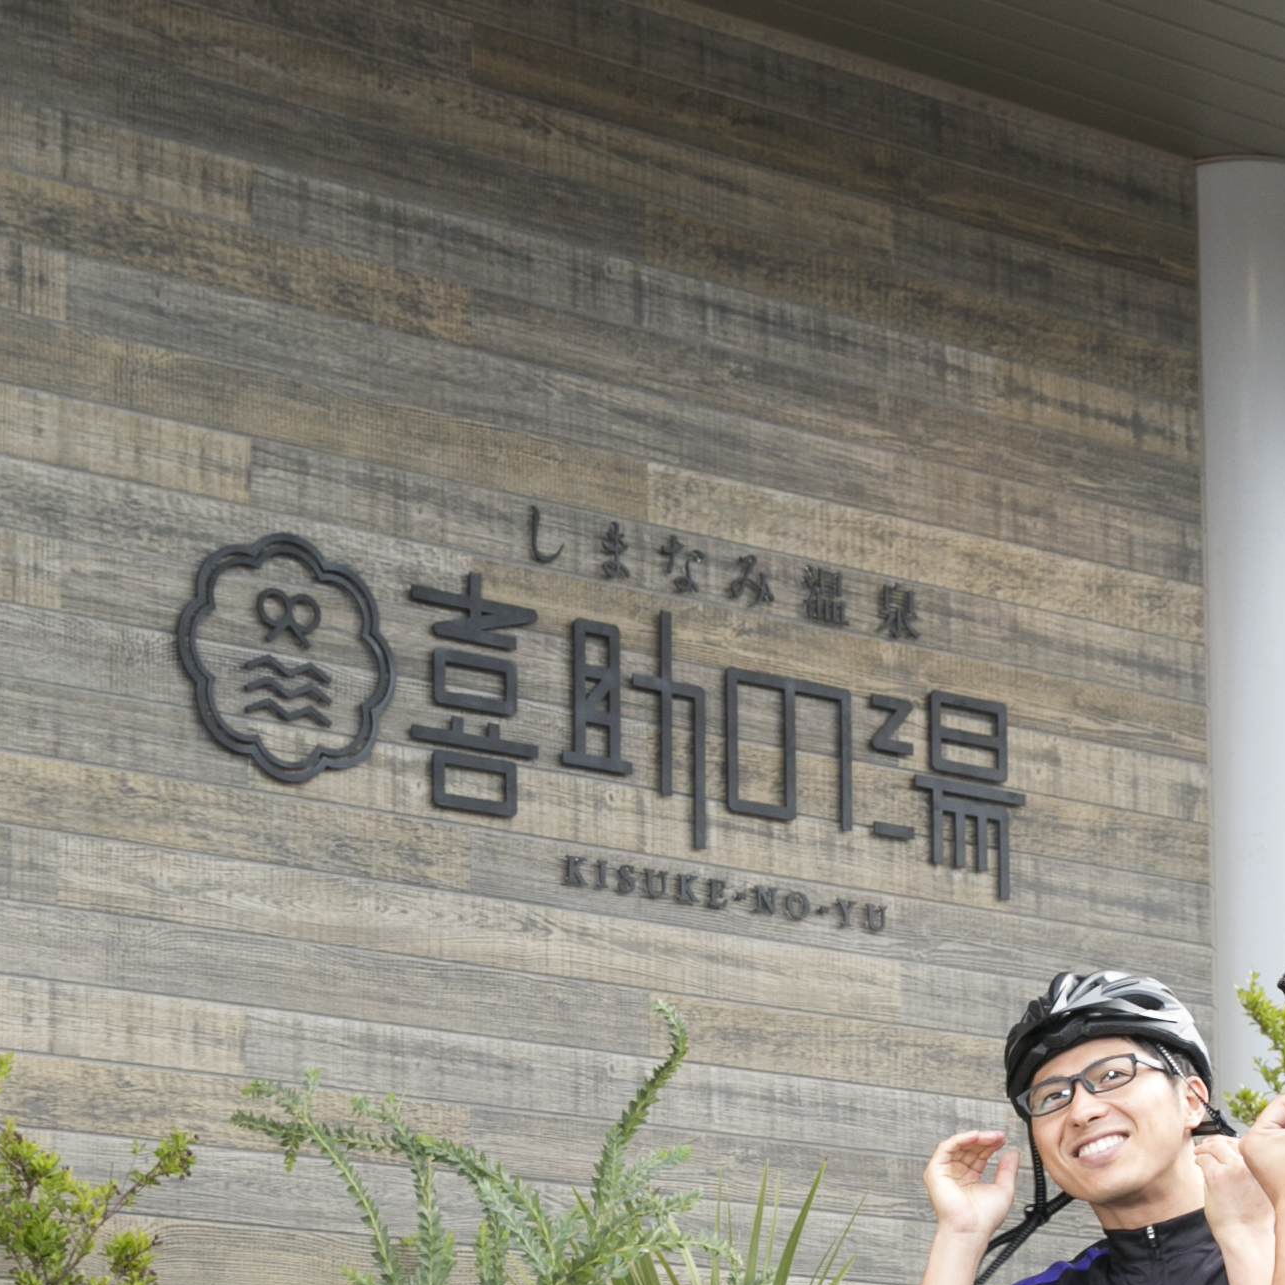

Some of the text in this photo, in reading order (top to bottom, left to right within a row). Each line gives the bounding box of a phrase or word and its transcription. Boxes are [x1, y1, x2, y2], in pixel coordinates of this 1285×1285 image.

[529, 505, 919, 639] しまなみ温泉
[409, 571, 1026, 902] 喜助の湯
